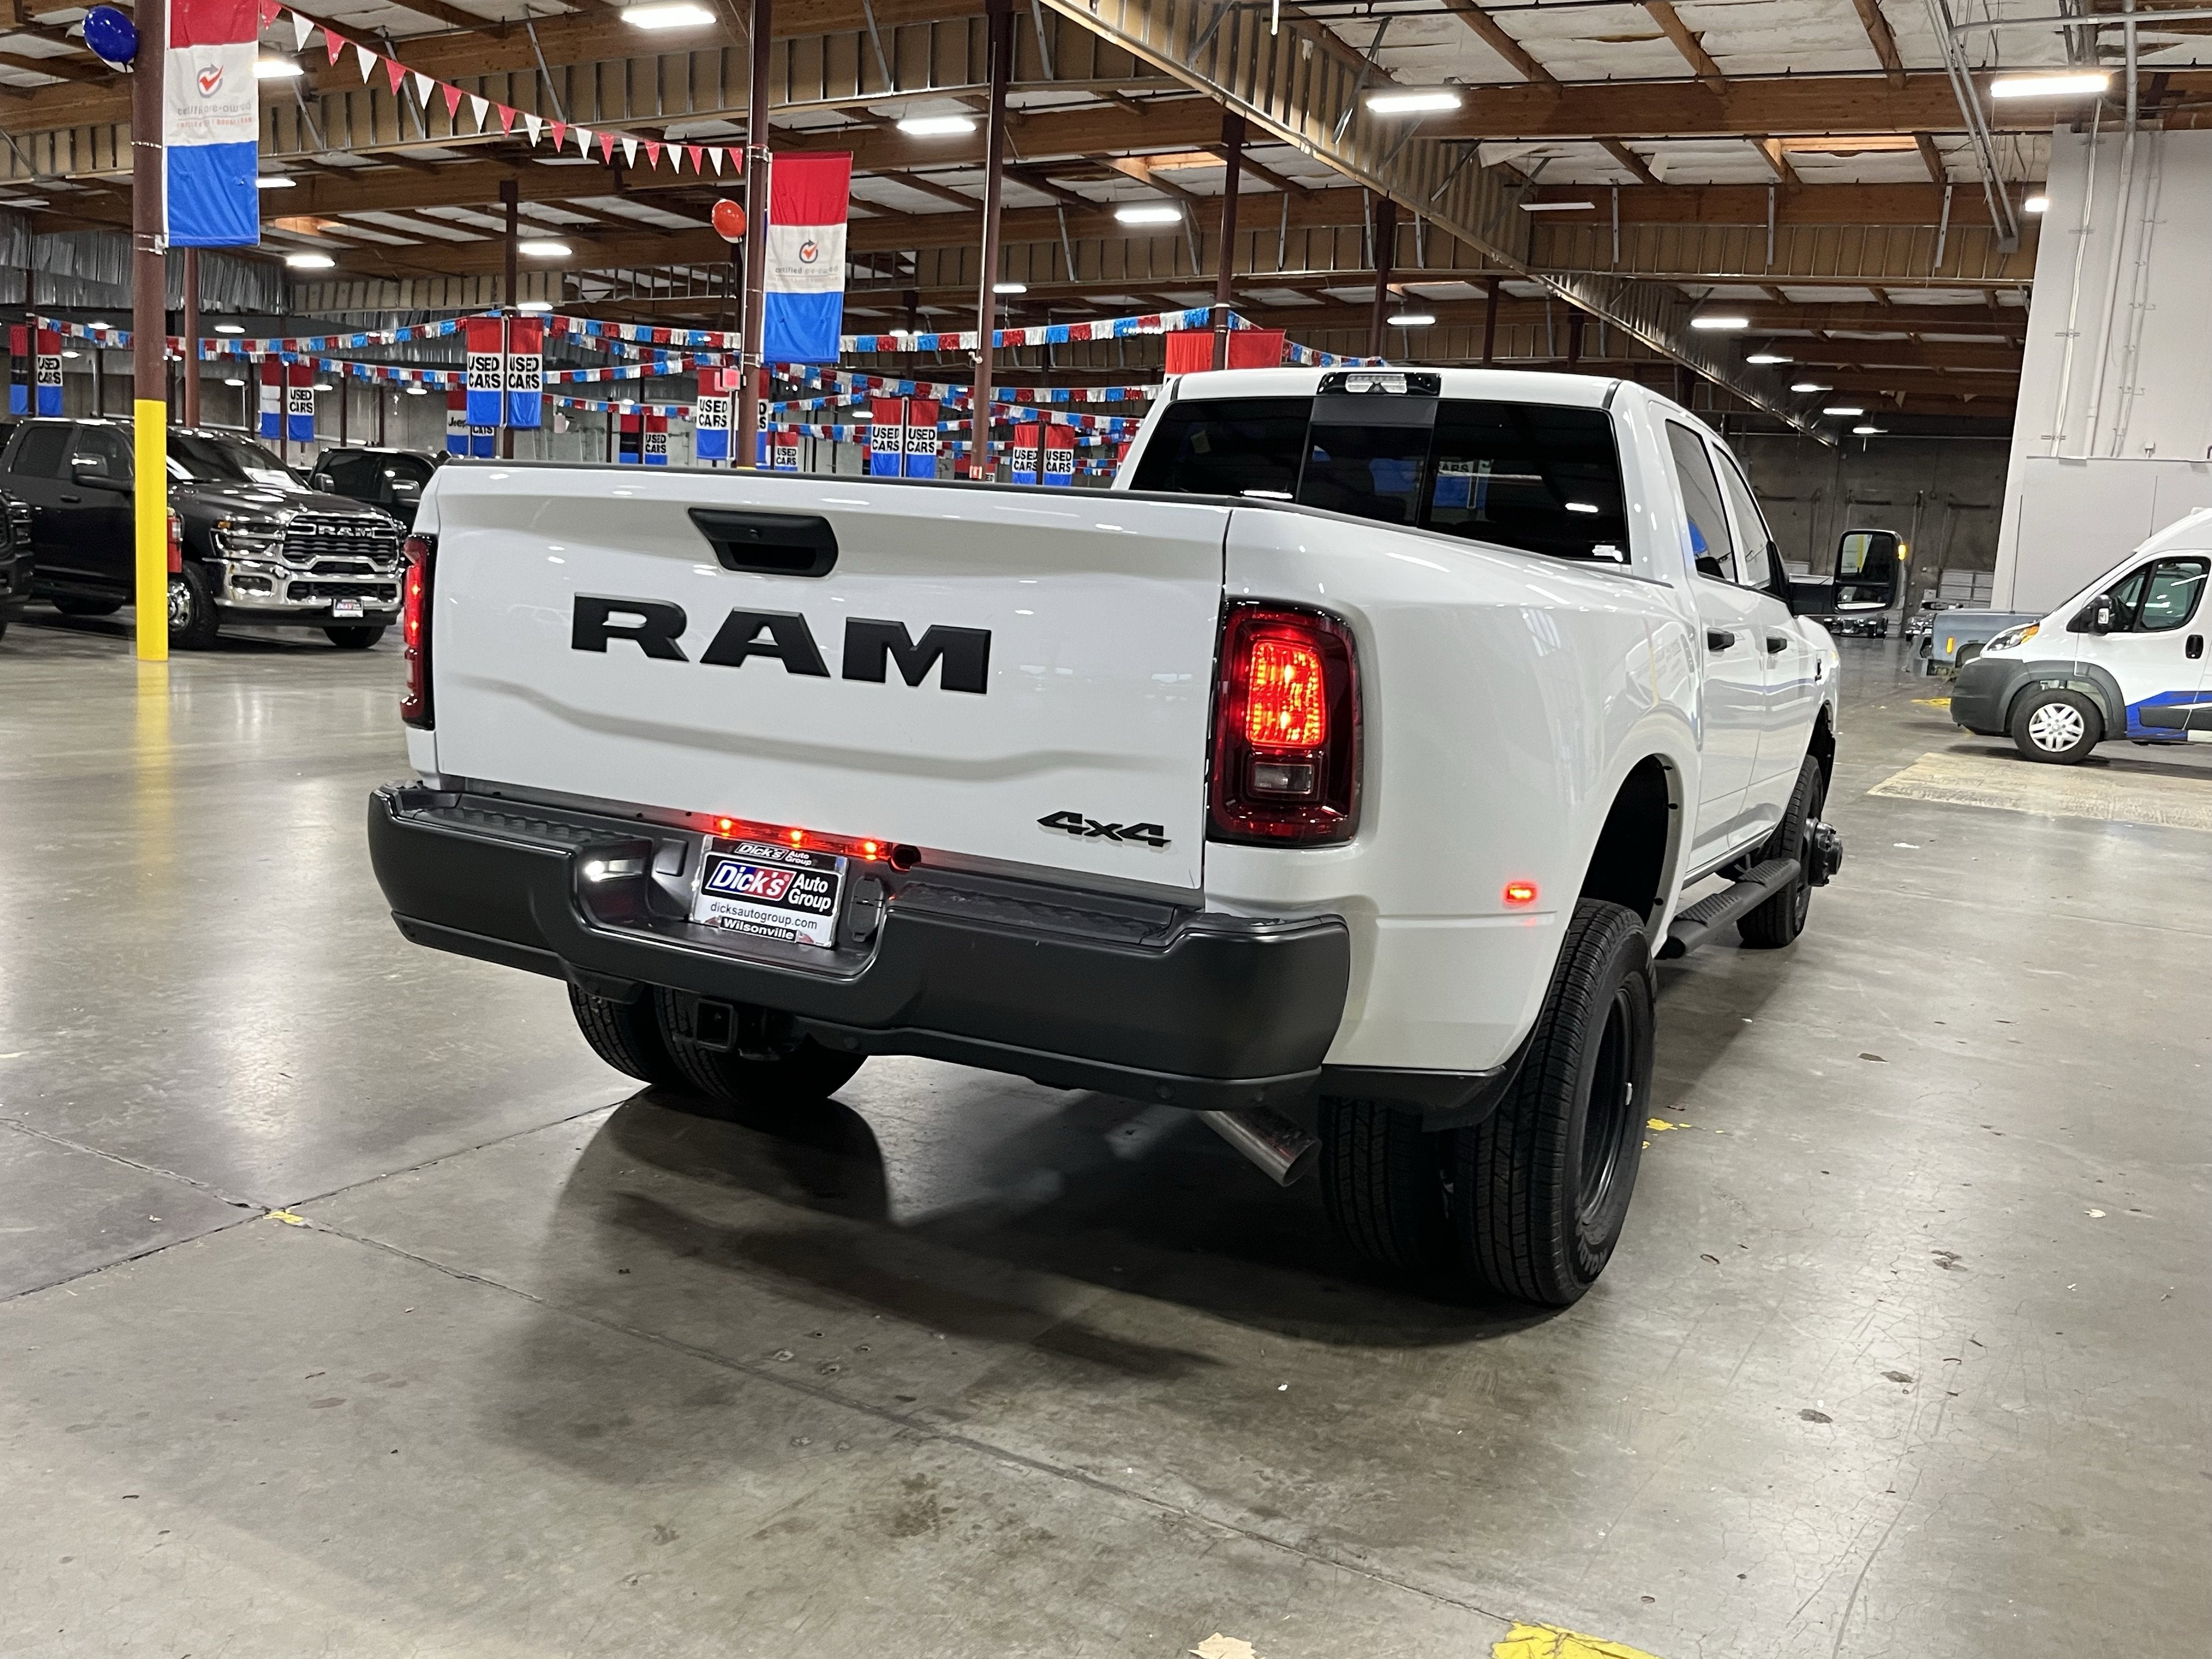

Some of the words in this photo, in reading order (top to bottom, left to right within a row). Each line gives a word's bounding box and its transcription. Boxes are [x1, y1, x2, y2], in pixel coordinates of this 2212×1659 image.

[204, 101, 251, 114] pre-owed
[469, 356, 499, 371] USED
[510, 357, 539, 372] USED
[469, 373, 501, 388] CARS
[509, 374, 539, 389] CARS
[291, 388, 312, 400] USED
[290, 402, 313, 413] CARS
[699, 399, 727, 413] USED
[699, 414, 727, 427] CARS
[646, 435, 666, 443] USED
[873, 427, 899, 439] USED
[908, 428, 935, 440] USED
[646, 444, 666, 453] CARS
[872, 439, 899, 451] CARS
[907, 441, 934, 453] CARS
[777, 448, 796, 456] USED
[1015, 449, 1037, 460] USED
[1046, 451, 1071, 461] USED
[776, 457, 796, 465] CARS
[1014, 461, 1037, 471] CARS
[1046, 461, 1071, 472] CARS
[318, 525, 372, 537] RAM
[571, 591, 992, 695] RAM
[738, 844, 785, 859] Dick's
[789, 850, 810, 859] Auto
[785, 856, 812, 866] Group
[712, 865, 785, 896] Dick's
[793, 873, 828, 893] Auto
[788, 889, 832, 912] Group
[710, 901, 817, 930] dicksautogroup.com
[724, 917, 794, 940] Wilsonville
